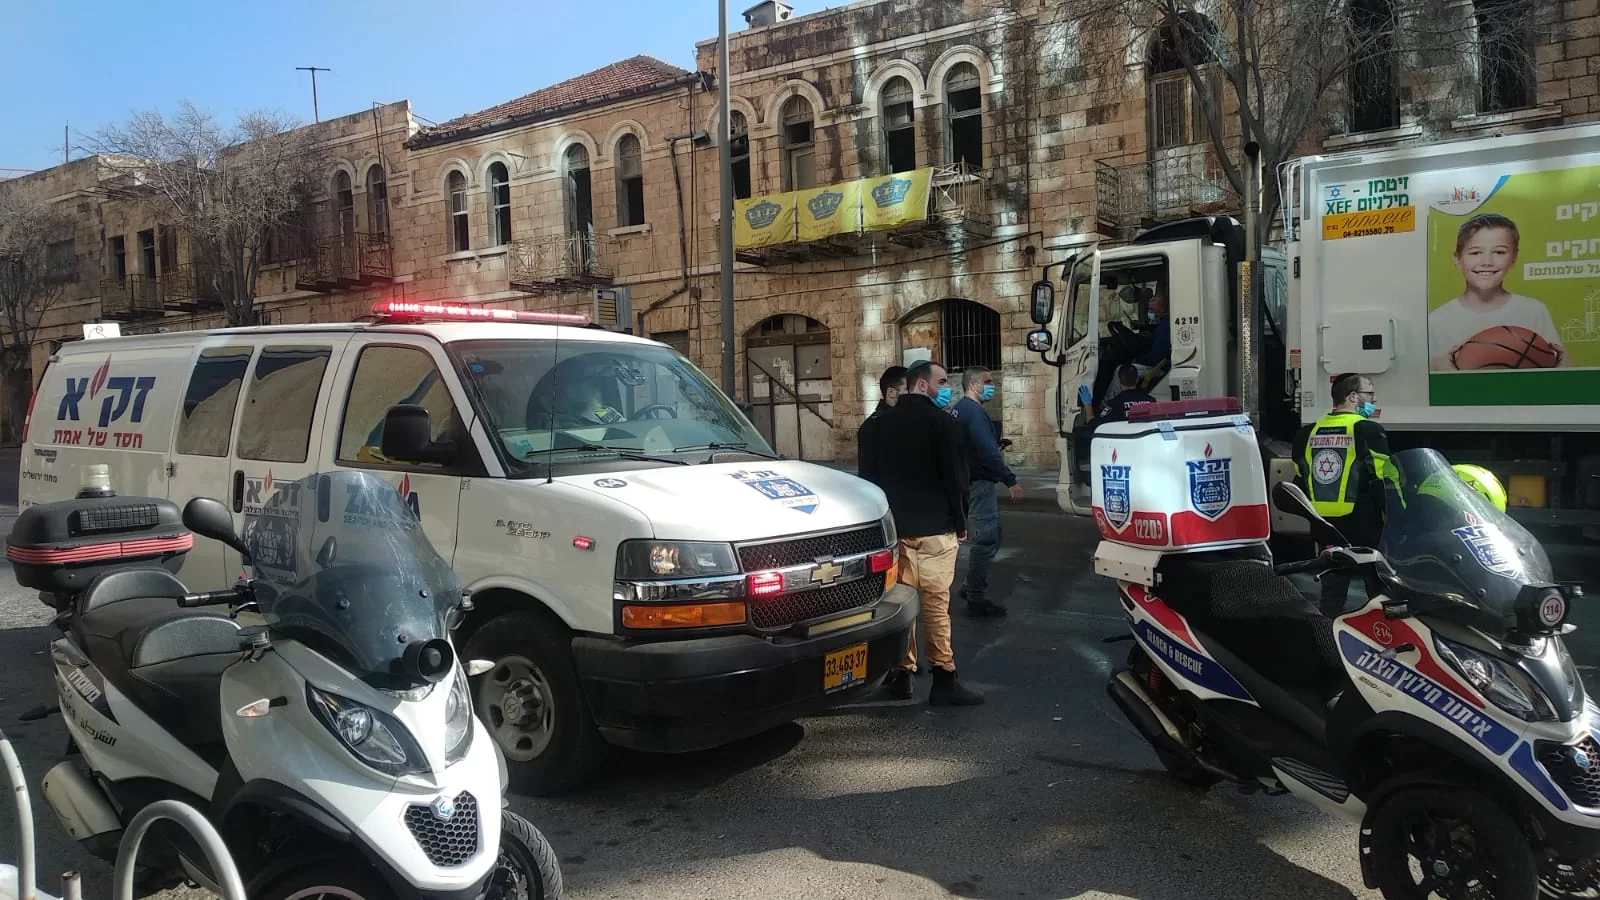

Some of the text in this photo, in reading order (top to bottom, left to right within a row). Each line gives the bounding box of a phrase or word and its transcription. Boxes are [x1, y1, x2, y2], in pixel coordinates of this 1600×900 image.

[1368, 176, 1409, 196] זיטמן
[1326, 193, 1409, 215] מילניום XEF
[1556, 202, 1600, 222] קים
[53, 426, 143, 448] חסד של אמת
[1100, 465, 1131, 481] זקא
[1186, 458, 1231, 475] זקא
[1374, 626, 1391, 638] 214
[1146, 628, 1168, 655] SEARCH
[1174, 648, 1203, 675] RESCUE
[67, 667, 102, 703] משטרה
[1355, 651, 1493, 738] איתור חילוץ הצלה
[80, 719, 117, 746] الشرطة
